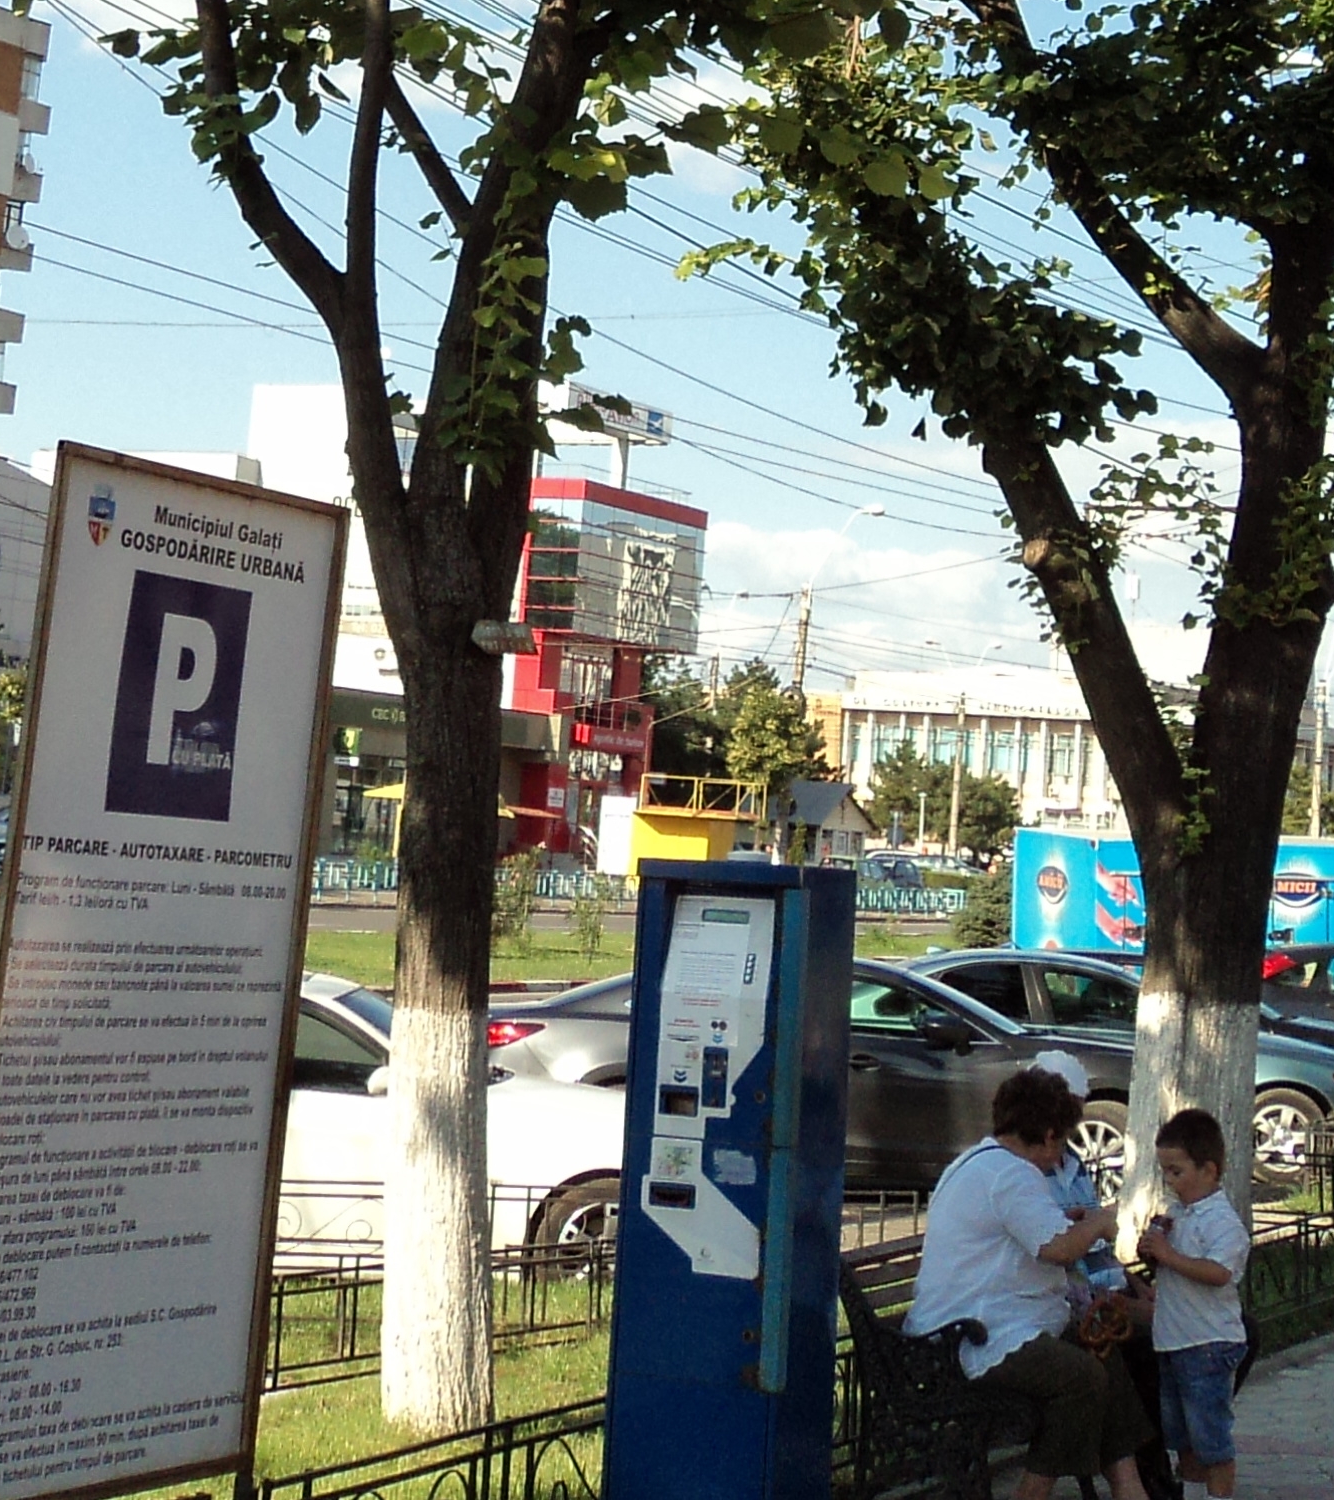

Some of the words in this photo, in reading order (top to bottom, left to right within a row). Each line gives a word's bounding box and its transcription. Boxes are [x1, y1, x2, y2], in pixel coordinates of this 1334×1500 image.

[154, 505, 234, 539] Municipiul
[121, 528, 236, 569] GOSPODĂRIRE
[241, 553, 305, 583] URBANĂ
[146, 612, 217, 765] P
[20, 834, 44, 851] TIP
[46, 836, 109, 856] PARCARE
[119, 842, 204, 863] AUTOTAXARE
[213, 849, 292, 869] PARCOMETRU
